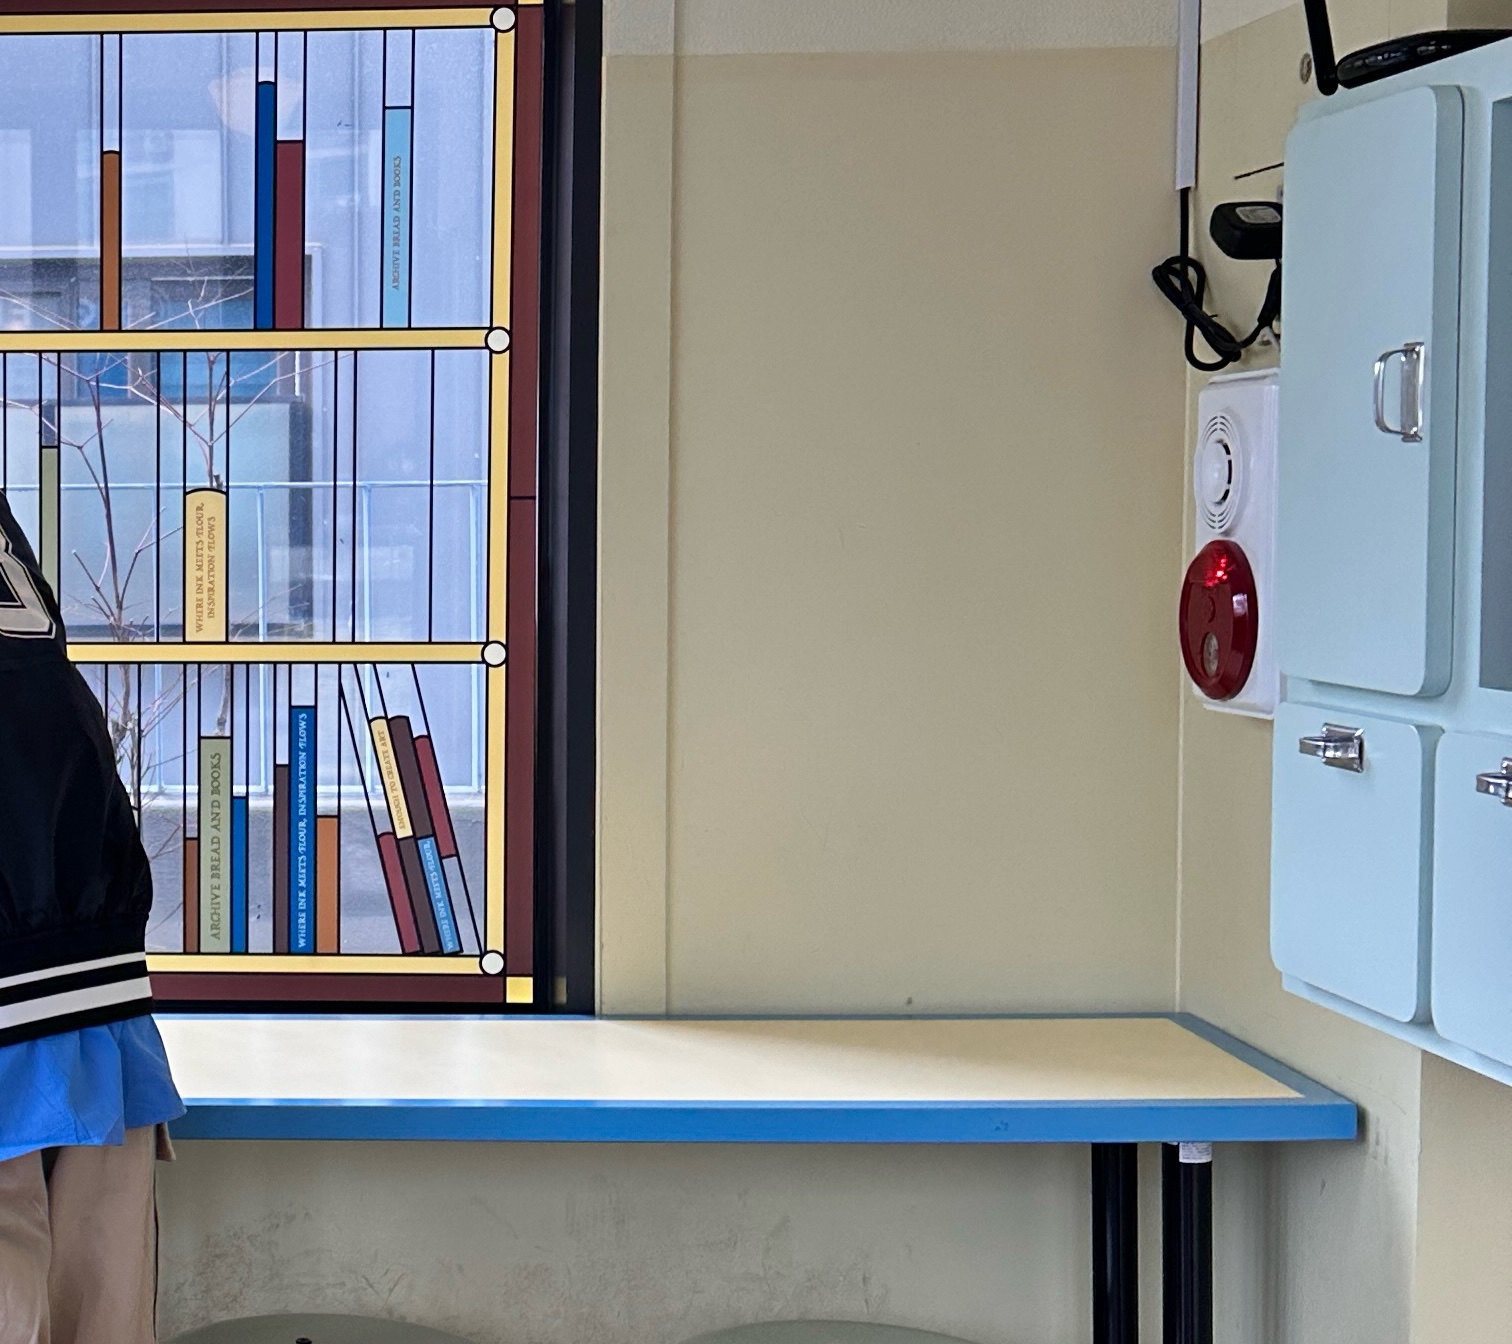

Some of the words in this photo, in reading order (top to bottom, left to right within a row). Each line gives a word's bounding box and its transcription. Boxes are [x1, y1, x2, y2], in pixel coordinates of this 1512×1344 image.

[393, 156, 402, 188] BOOKS
[392, 189, 401, 212] AND
[392, 216, 401, 247] BREAD
[392, 250, 400, 291] ARCHIVE
[206, 516, 216, 552] FLOWS
[195, 539, 205, 572] MEETS
[195, 574, 204, 595] INK
[207, 554, 216, 619] INSPIRATION
[195, 597, 205, 633] WHERE
[298, 713, 307, 750] FLOWS
[377, 730, 387, 746] ART
[210, 752, 222, 796] BOOKS
[382, 749, 393, 779] CREATE
[298, 751, 307, 816] INSPIRATION
[389, 781, 398, 793] TO
[210, 799, 221, 832] AND
[210, 835, 221, 880] BREAD
[297, 855, 307, 888] MEETS
[210, 884, 221, 941] ARCHIVE
[297, 889, 306, 910] INK
[297, 912, 307, 948] WHERE
